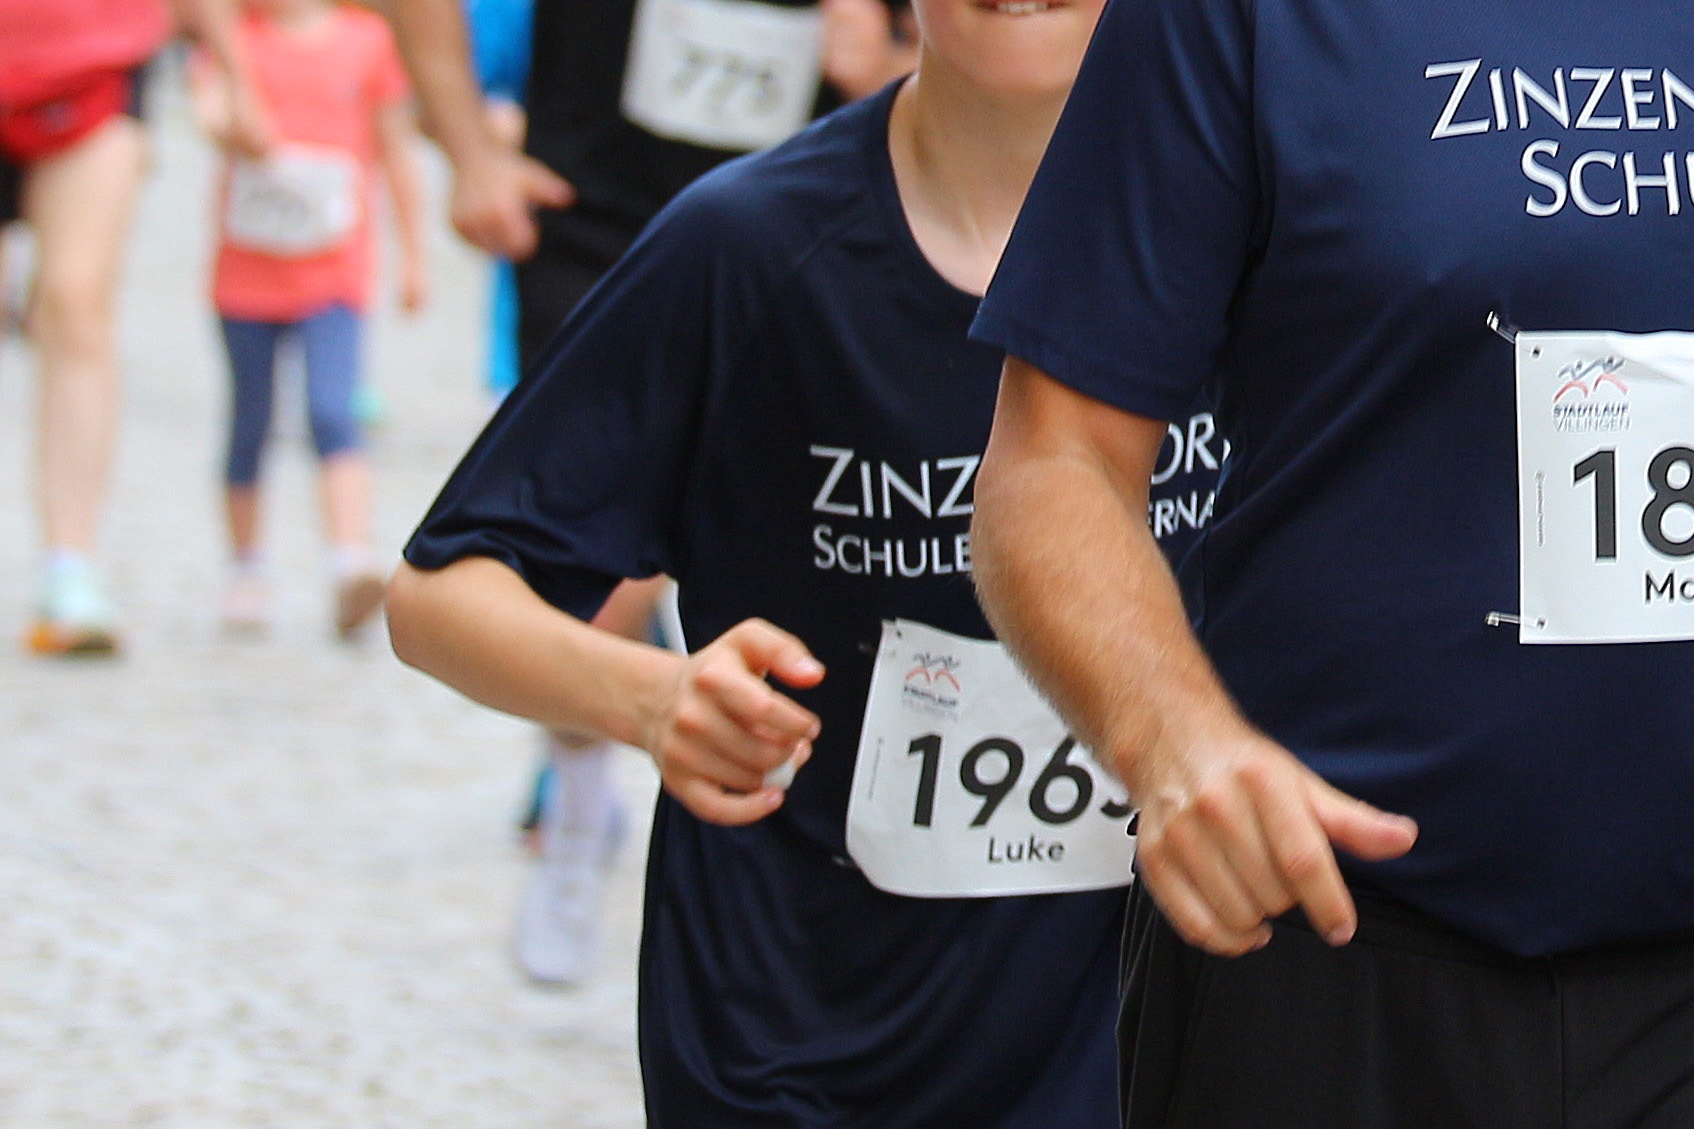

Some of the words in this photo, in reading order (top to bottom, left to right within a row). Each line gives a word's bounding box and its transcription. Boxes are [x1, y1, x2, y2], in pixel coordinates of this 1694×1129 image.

[1553, 404, 1629, 418] STADTLAUF
[908, 734, 1132, 828] 196
[988, 835, 1065, 863] Luke
